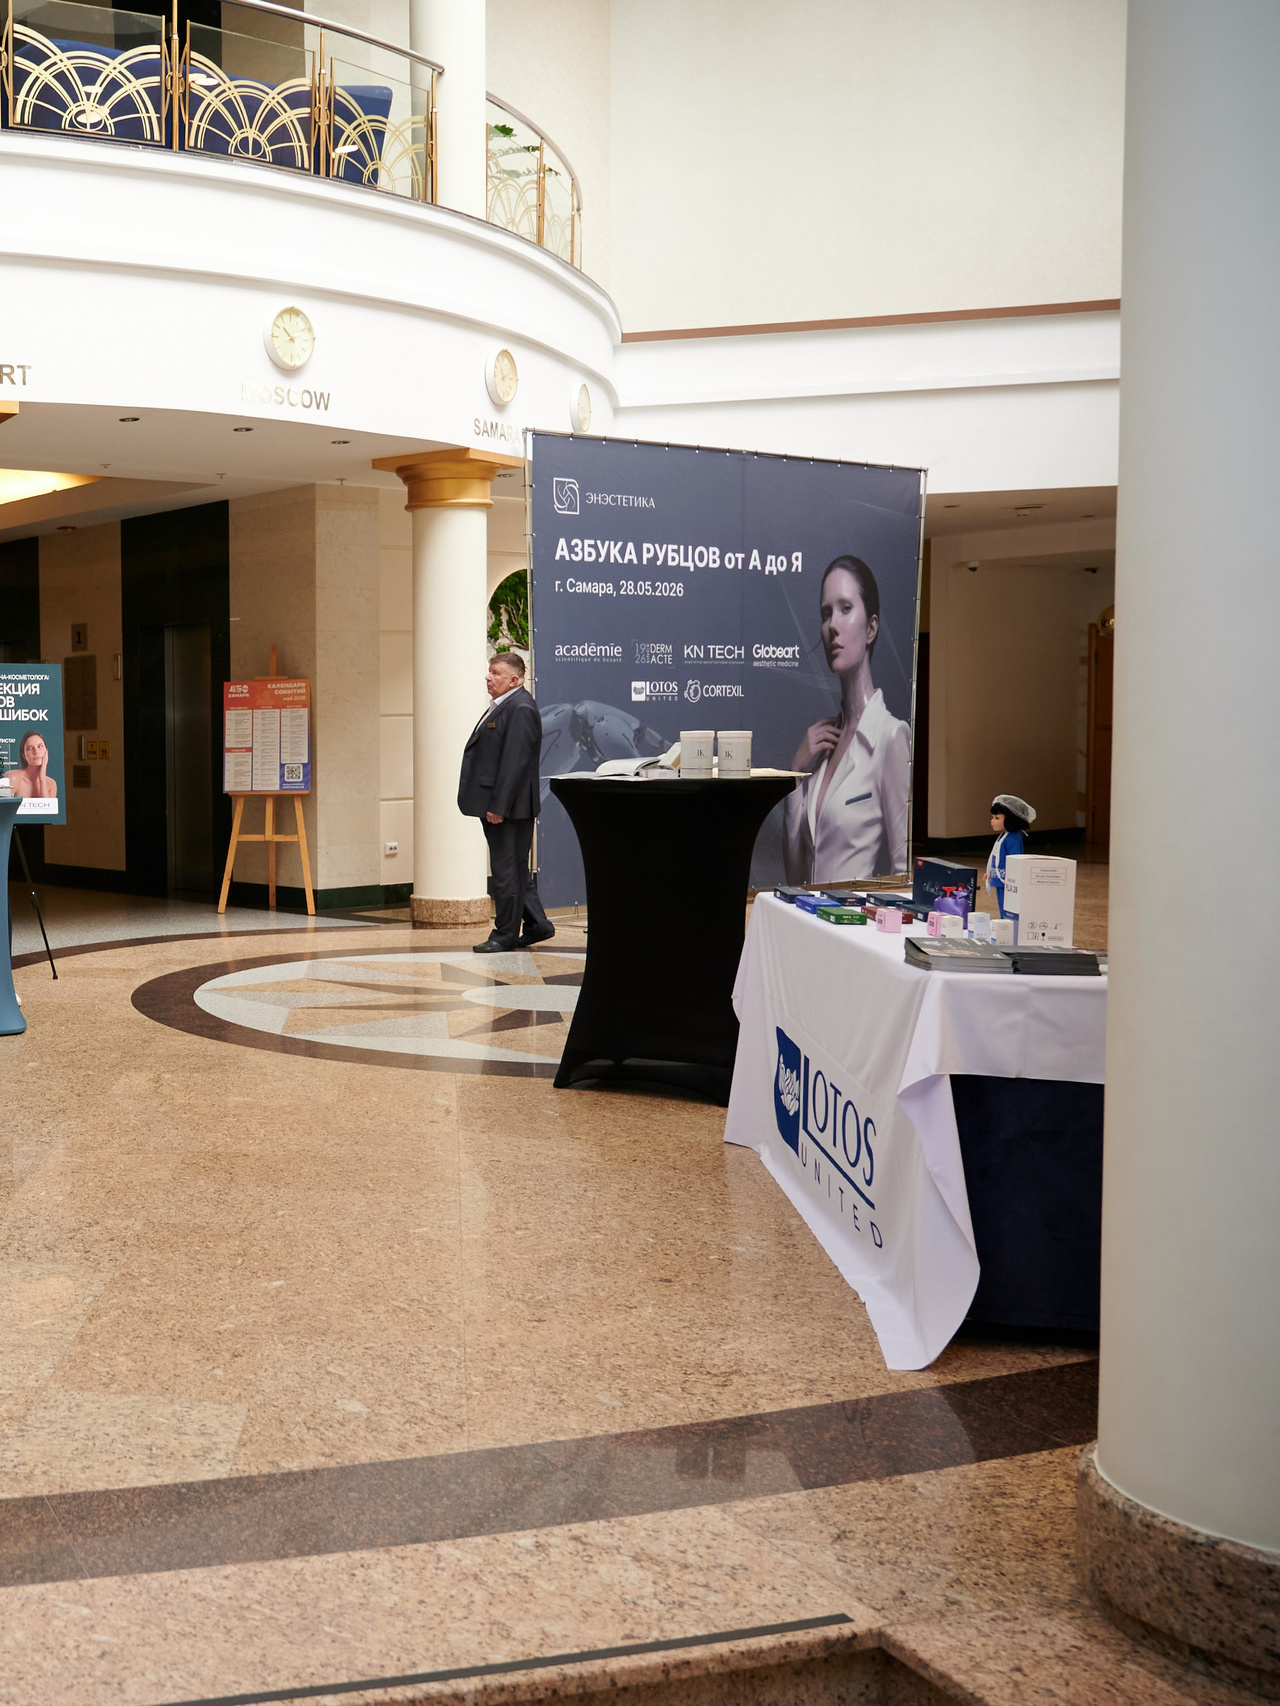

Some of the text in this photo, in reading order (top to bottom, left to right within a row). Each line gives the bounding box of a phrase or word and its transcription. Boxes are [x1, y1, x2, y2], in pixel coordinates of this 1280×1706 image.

[240, 381, 331, 411] MOSCOW
[585, 491, 656, 509] ЭНЭСТЕТИКА
[554, 537, 802, 576] АЗБУКА РУБЦОВ от А до Я
[555, 578, 684, 597] г. Самара, 28.05.2026
[650, 643, 673, 654] DERM
[684, 644, 745, 659] KN TECH
[752, 643, 800, 659] Globeart
[650, 654, 673, 665] ACTE
[646, 681, 678, 695] LOTOS
[703, 685, 745, 698] CORTEXIL
[802, 1054, 877, 1187] LOTOS
[801, 1142, 883, 1249] UNITED
